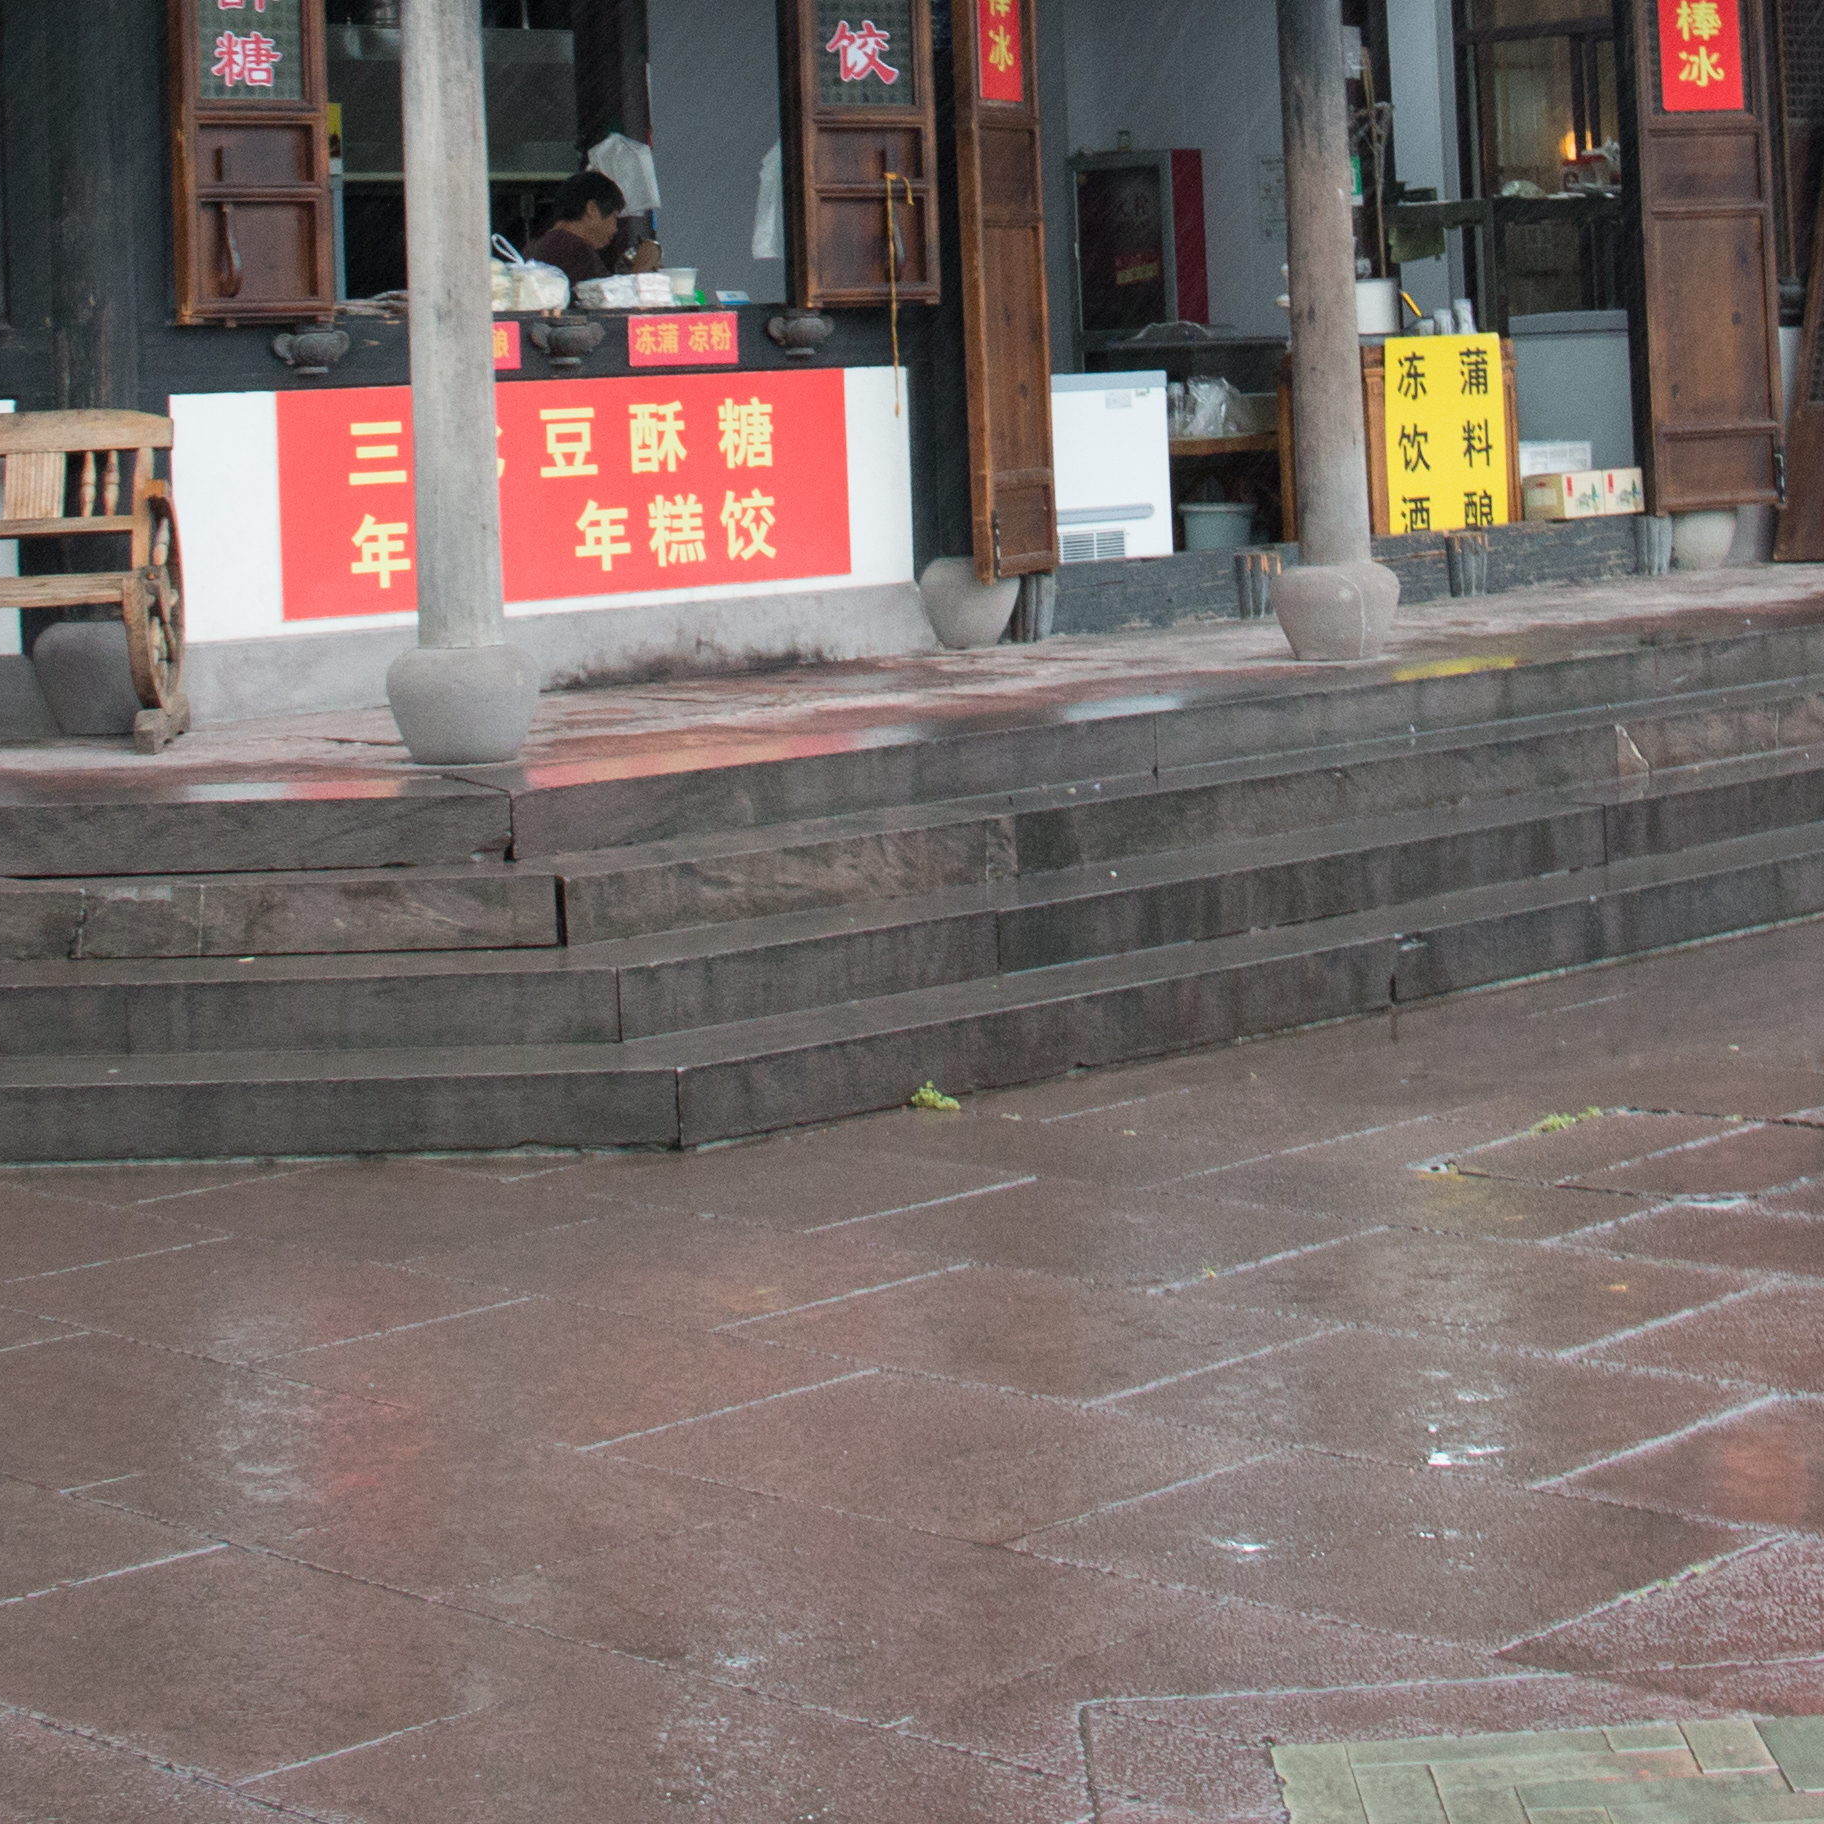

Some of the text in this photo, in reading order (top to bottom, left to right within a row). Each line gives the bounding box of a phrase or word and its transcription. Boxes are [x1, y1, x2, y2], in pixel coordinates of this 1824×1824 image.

[349, 396, 775, 487] 三豆酥糖
[575, 488, 777, 573] 年糕饺
